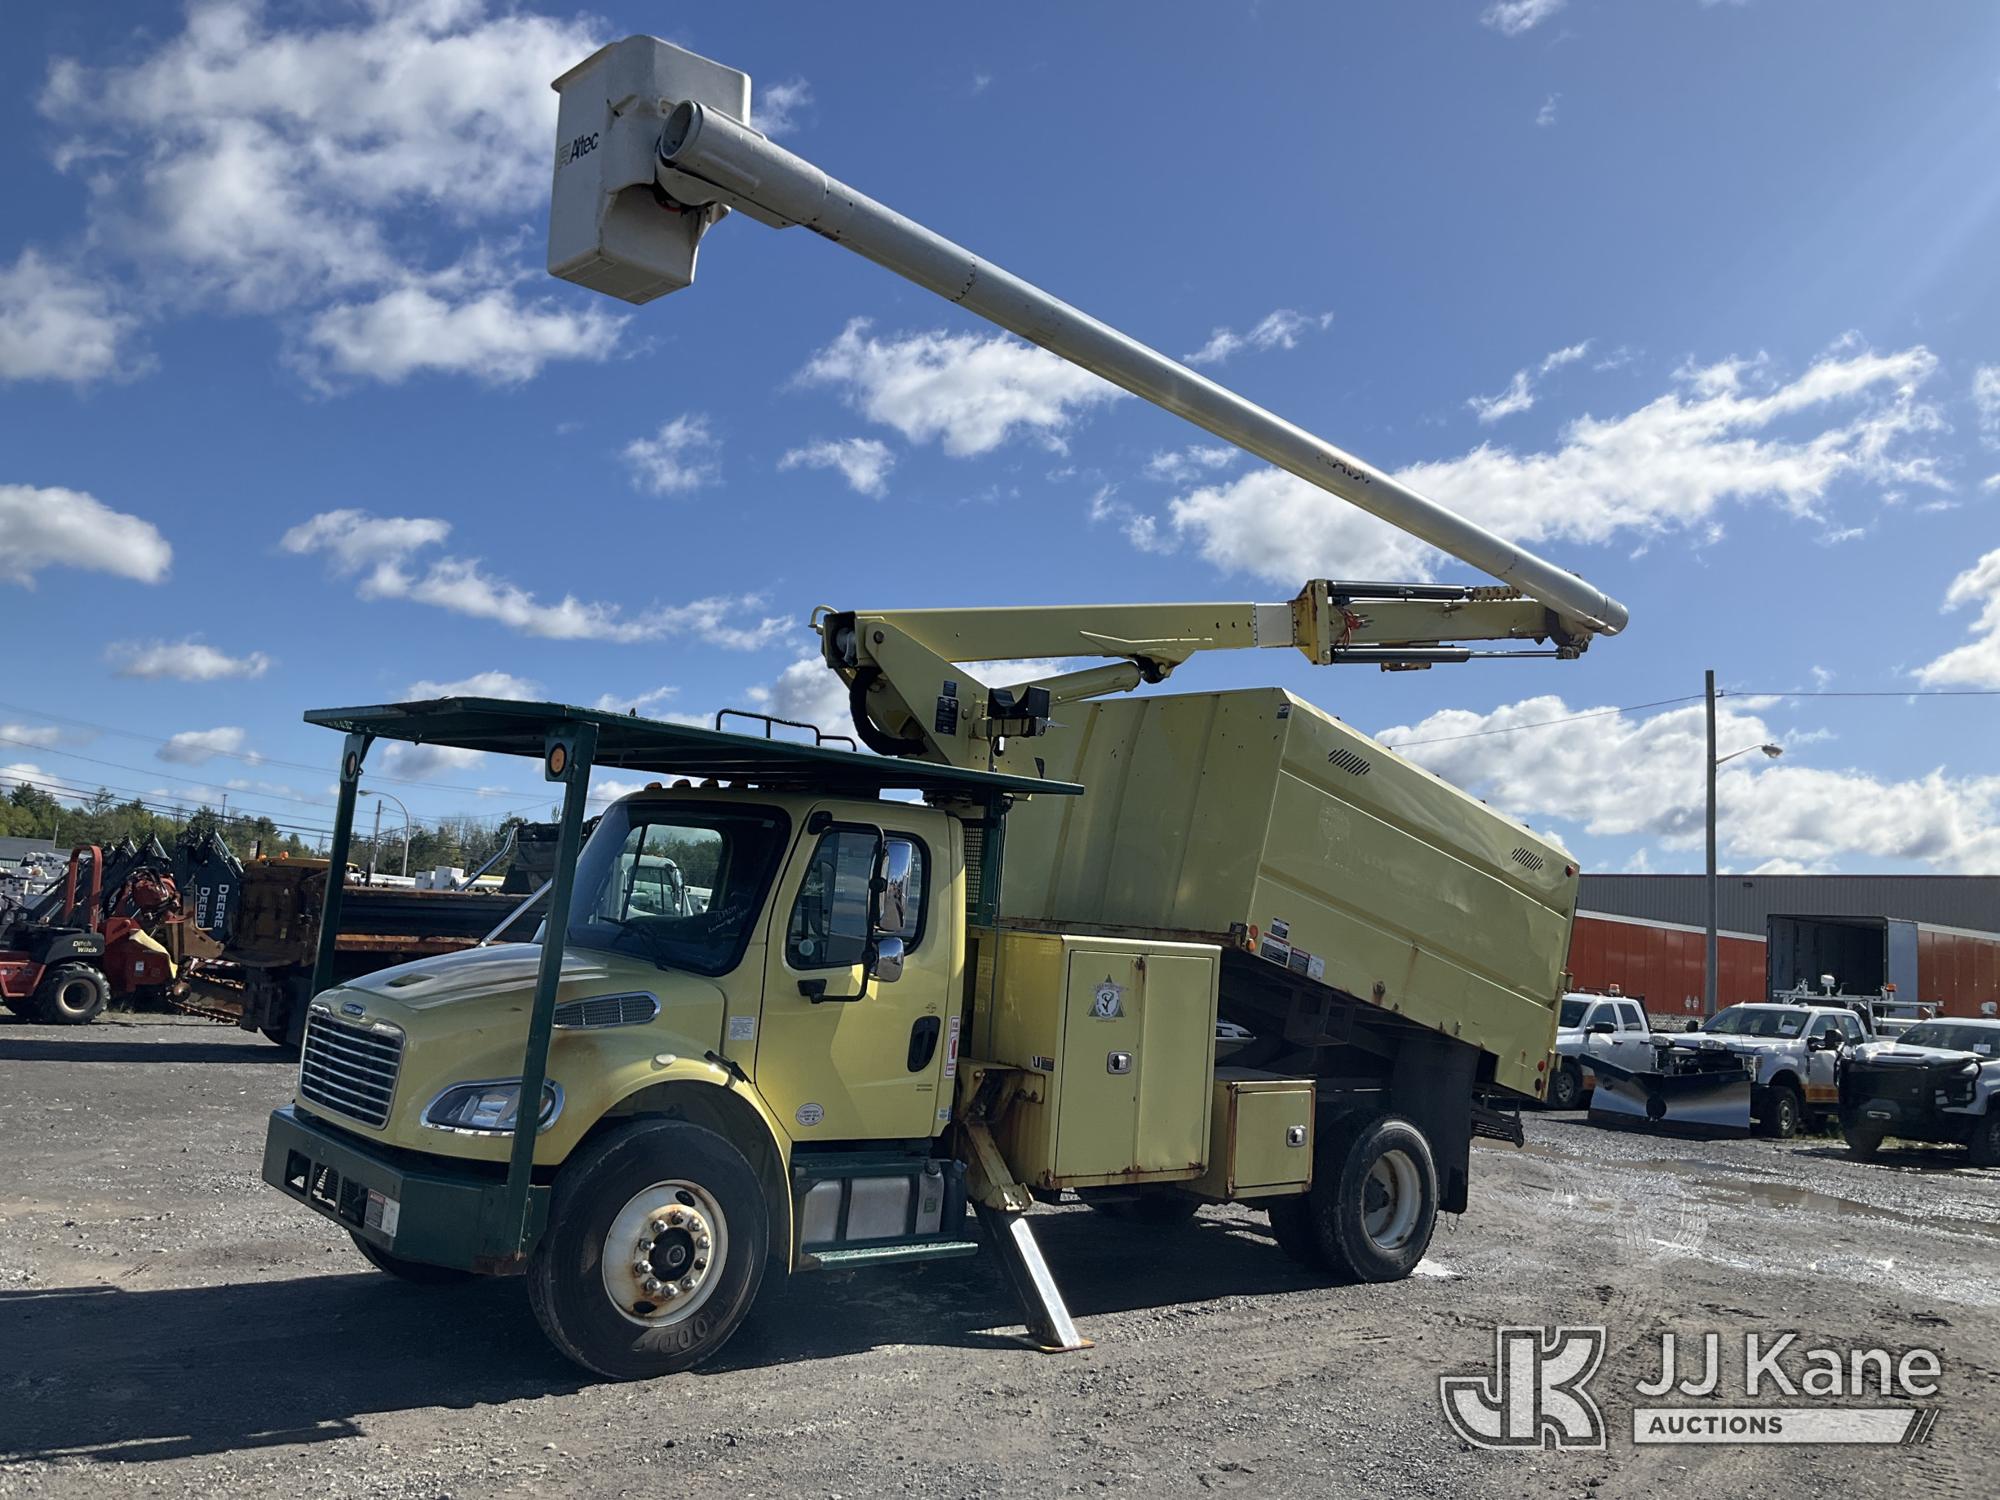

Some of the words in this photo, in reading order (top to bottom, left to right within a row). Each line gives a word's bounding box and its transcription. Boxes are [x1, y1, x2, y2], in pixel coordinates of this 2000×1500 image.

[570, 132, 599, 163] Altec
[197, 886, 211, 928] DEERE
[213, 884, 230, 928] DEERE
